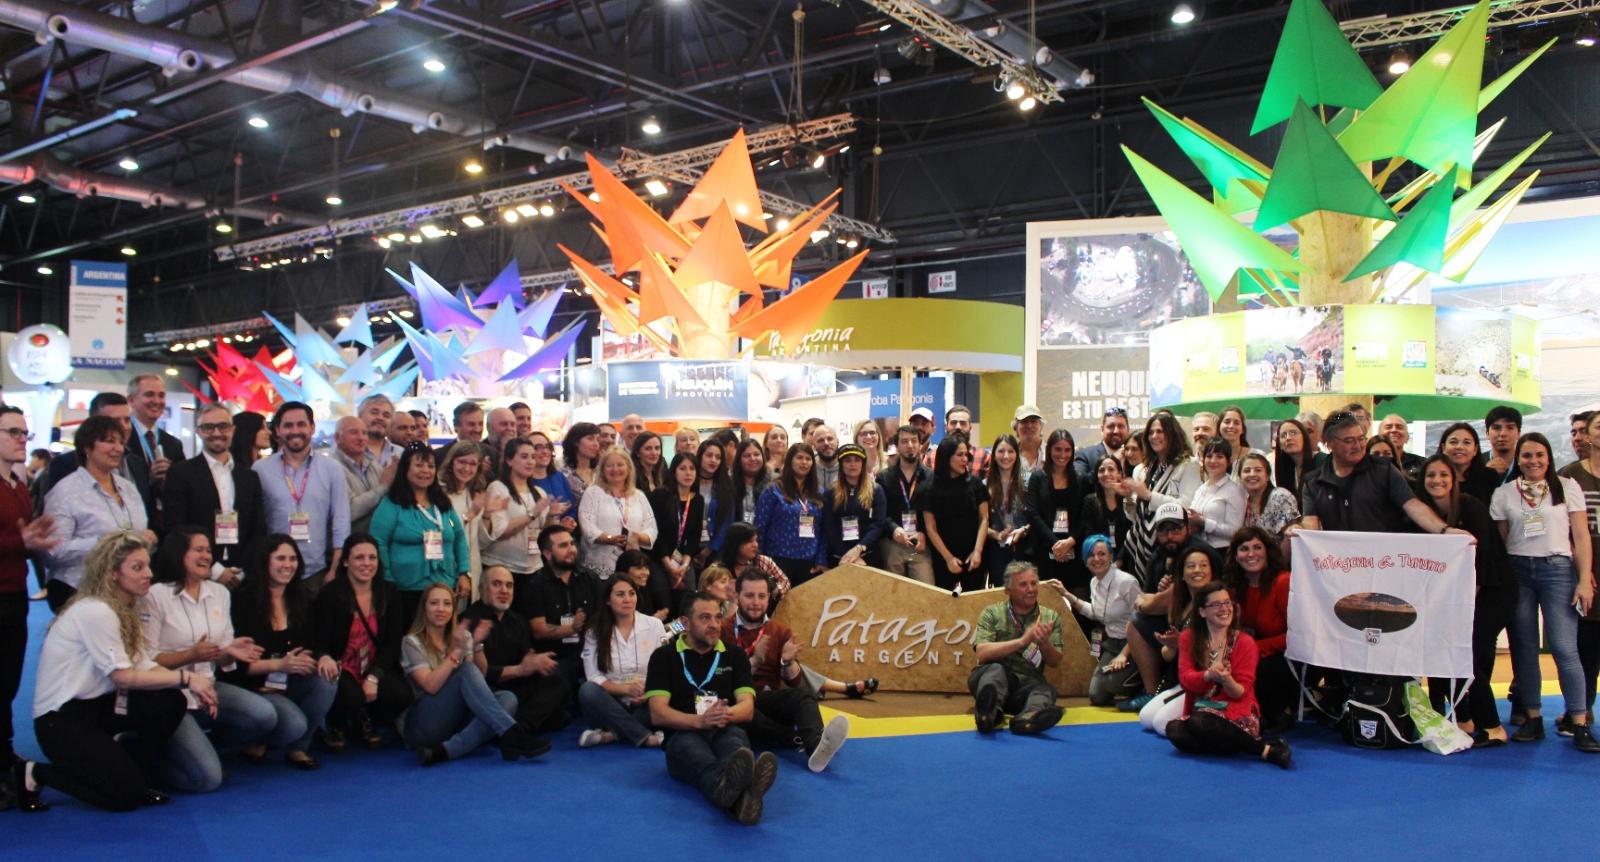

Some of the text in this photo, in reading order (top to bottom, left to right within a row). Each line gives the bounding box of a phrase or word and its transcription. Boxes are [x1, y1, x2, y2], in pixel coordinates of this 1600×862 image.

[83, 270, 126, 281] ARGENTINA
[1072, 370, 1149, 397] NEUQU
[890, 392, 934, 406] Pagonia
[1398, 553, 1447, 574] Turismo
[811, 594, 978, 669] Patago
[829, 648, 980, 665] ARGENT
